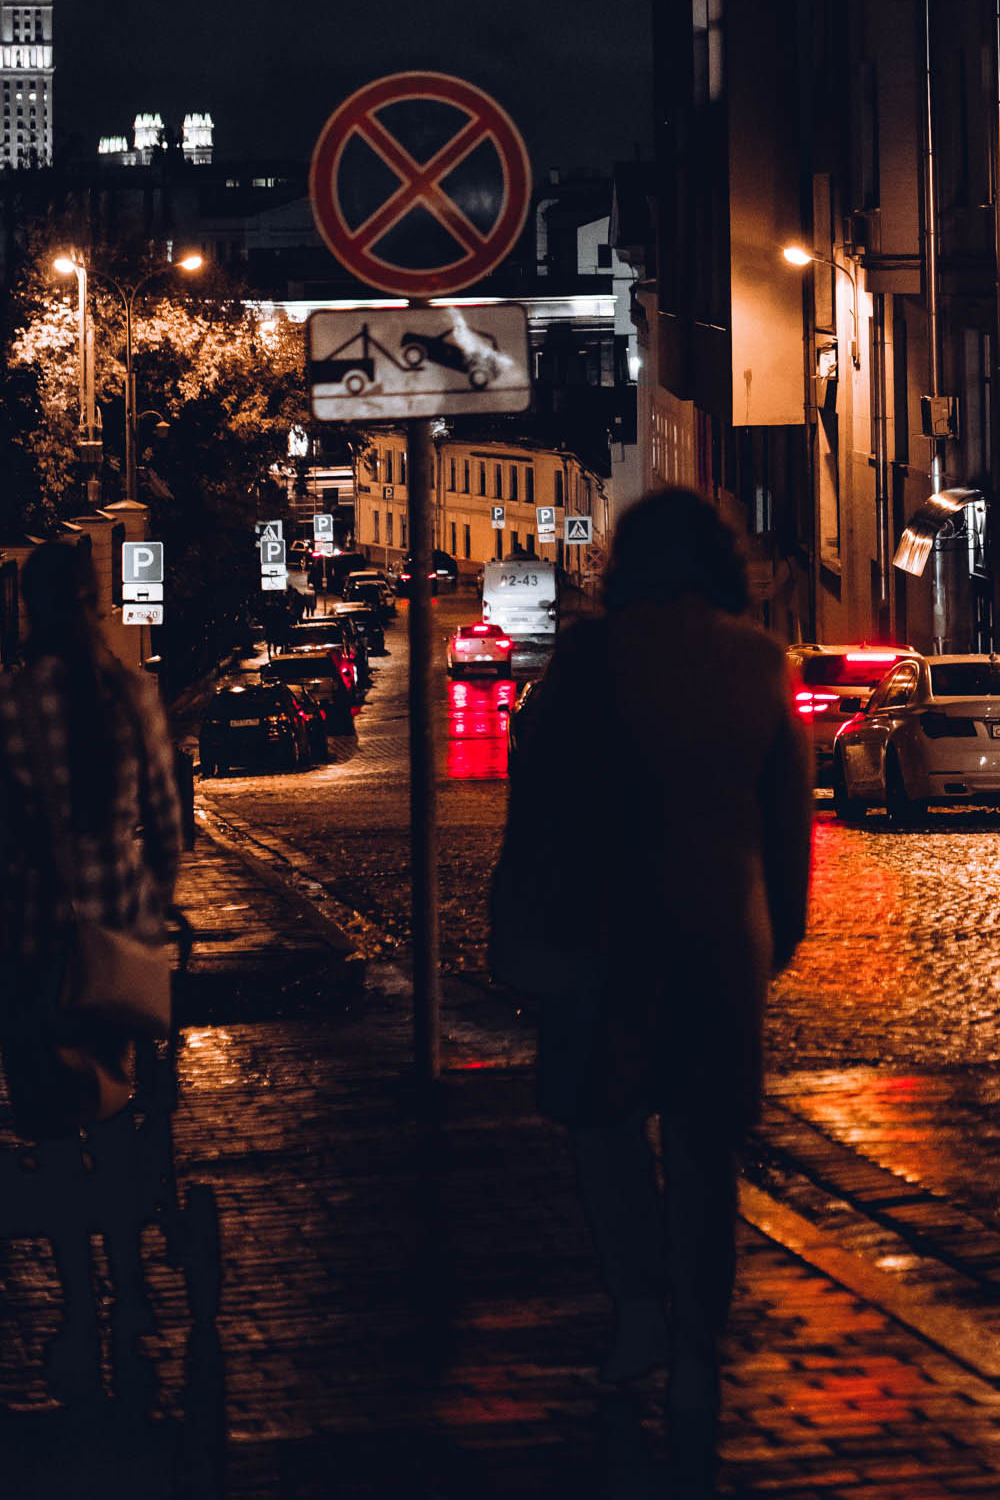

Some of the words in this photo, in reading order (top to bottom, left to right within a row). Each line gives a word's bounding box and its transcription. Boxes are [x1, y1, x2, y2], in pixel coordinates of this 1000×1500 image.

[494, 508, 503, 520] P
[541, 509, 551, 523] P
[318, 517, 329, 532] P
[267, 542, 281, 562] P
[133, 547, 154, 578] P
